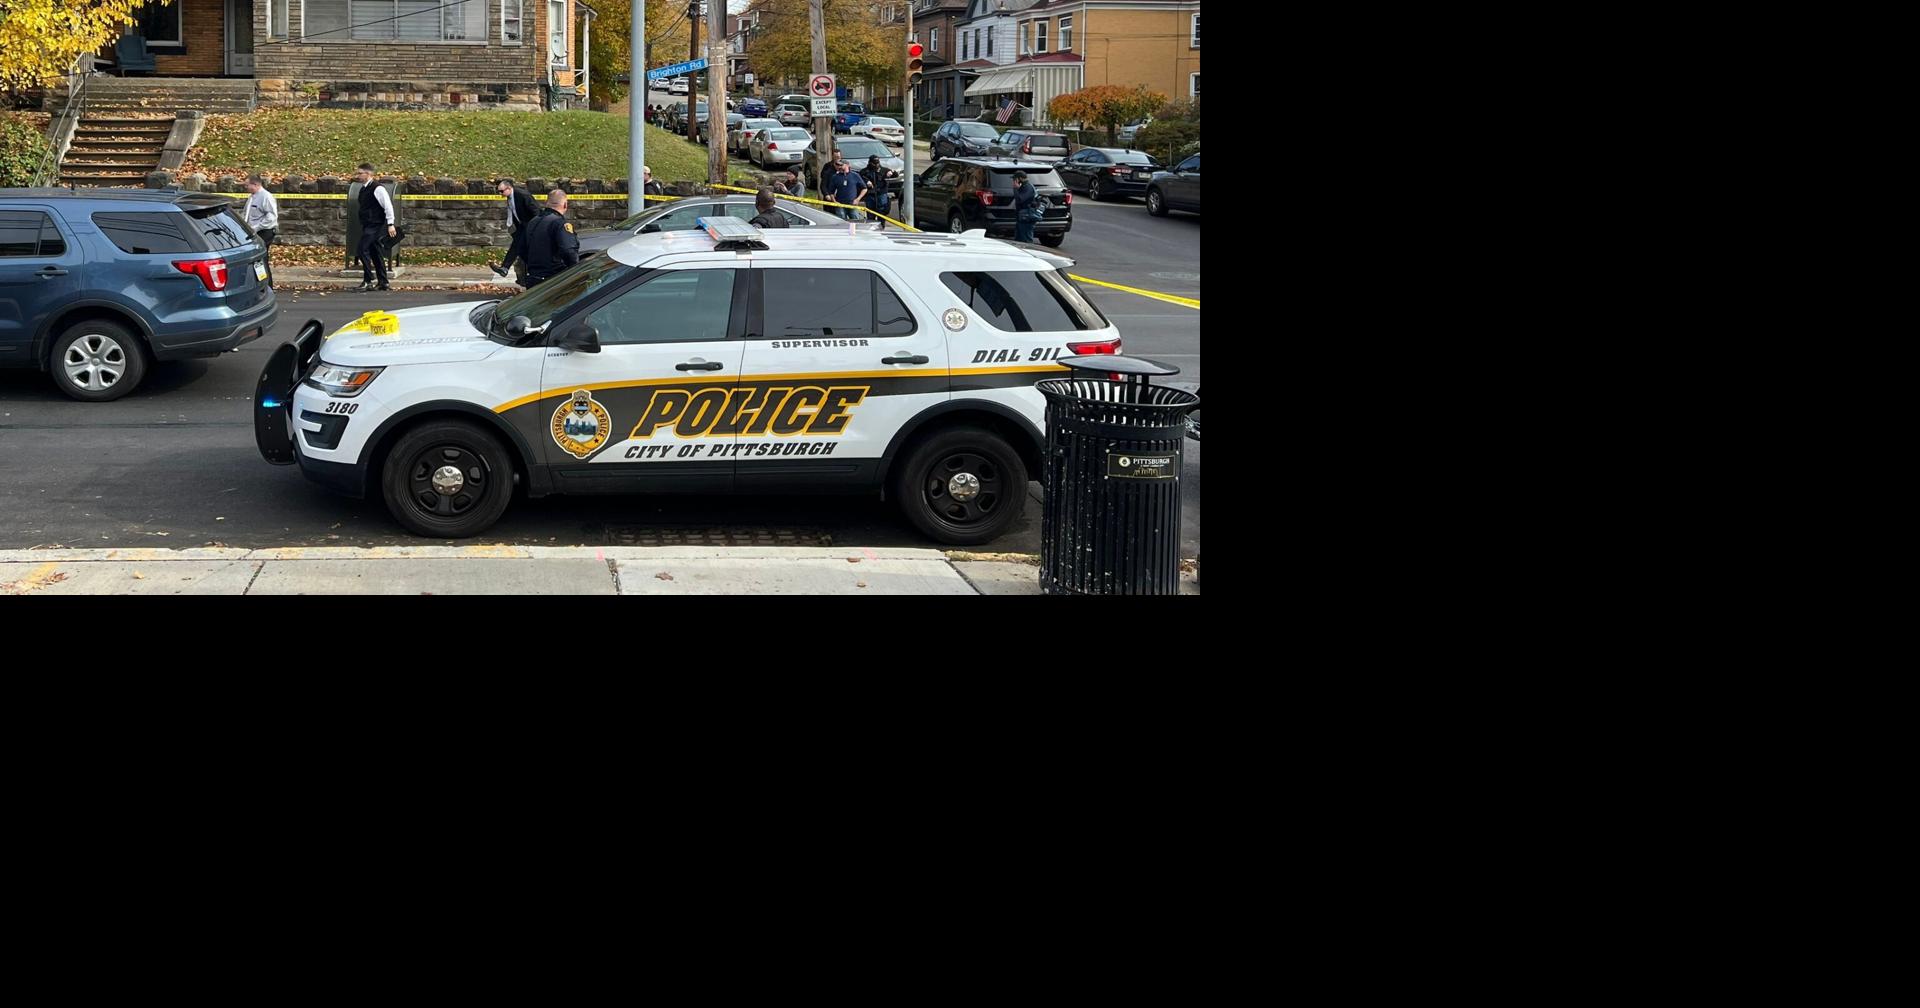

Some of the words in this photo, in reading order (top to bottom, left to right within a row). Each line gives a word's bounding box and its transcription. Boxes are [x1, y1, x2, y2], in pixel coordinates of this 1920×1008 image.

[650, 65, 687, 78] Brighton
[690, 60, 702, 69] Rd
[771, 339, 869, 349] SUPERVISOR
[971, 349, 1021, 363] DIAL
[1028, 347, 1061, 361] 911
[325, 401, 359, 415] 3180
[631, 387, 869, 438] POLICE
[554, 408, 569, 445] PITTSBURGH
[599, 413, 607, 438] POLICE
[624, 445, 674, 459] CITY
[677, 444, 705, 458] OF
[708, 442, 838, 458] PITTSBURGH
[1132, 457, 1170, 465] PITTSBURGH
